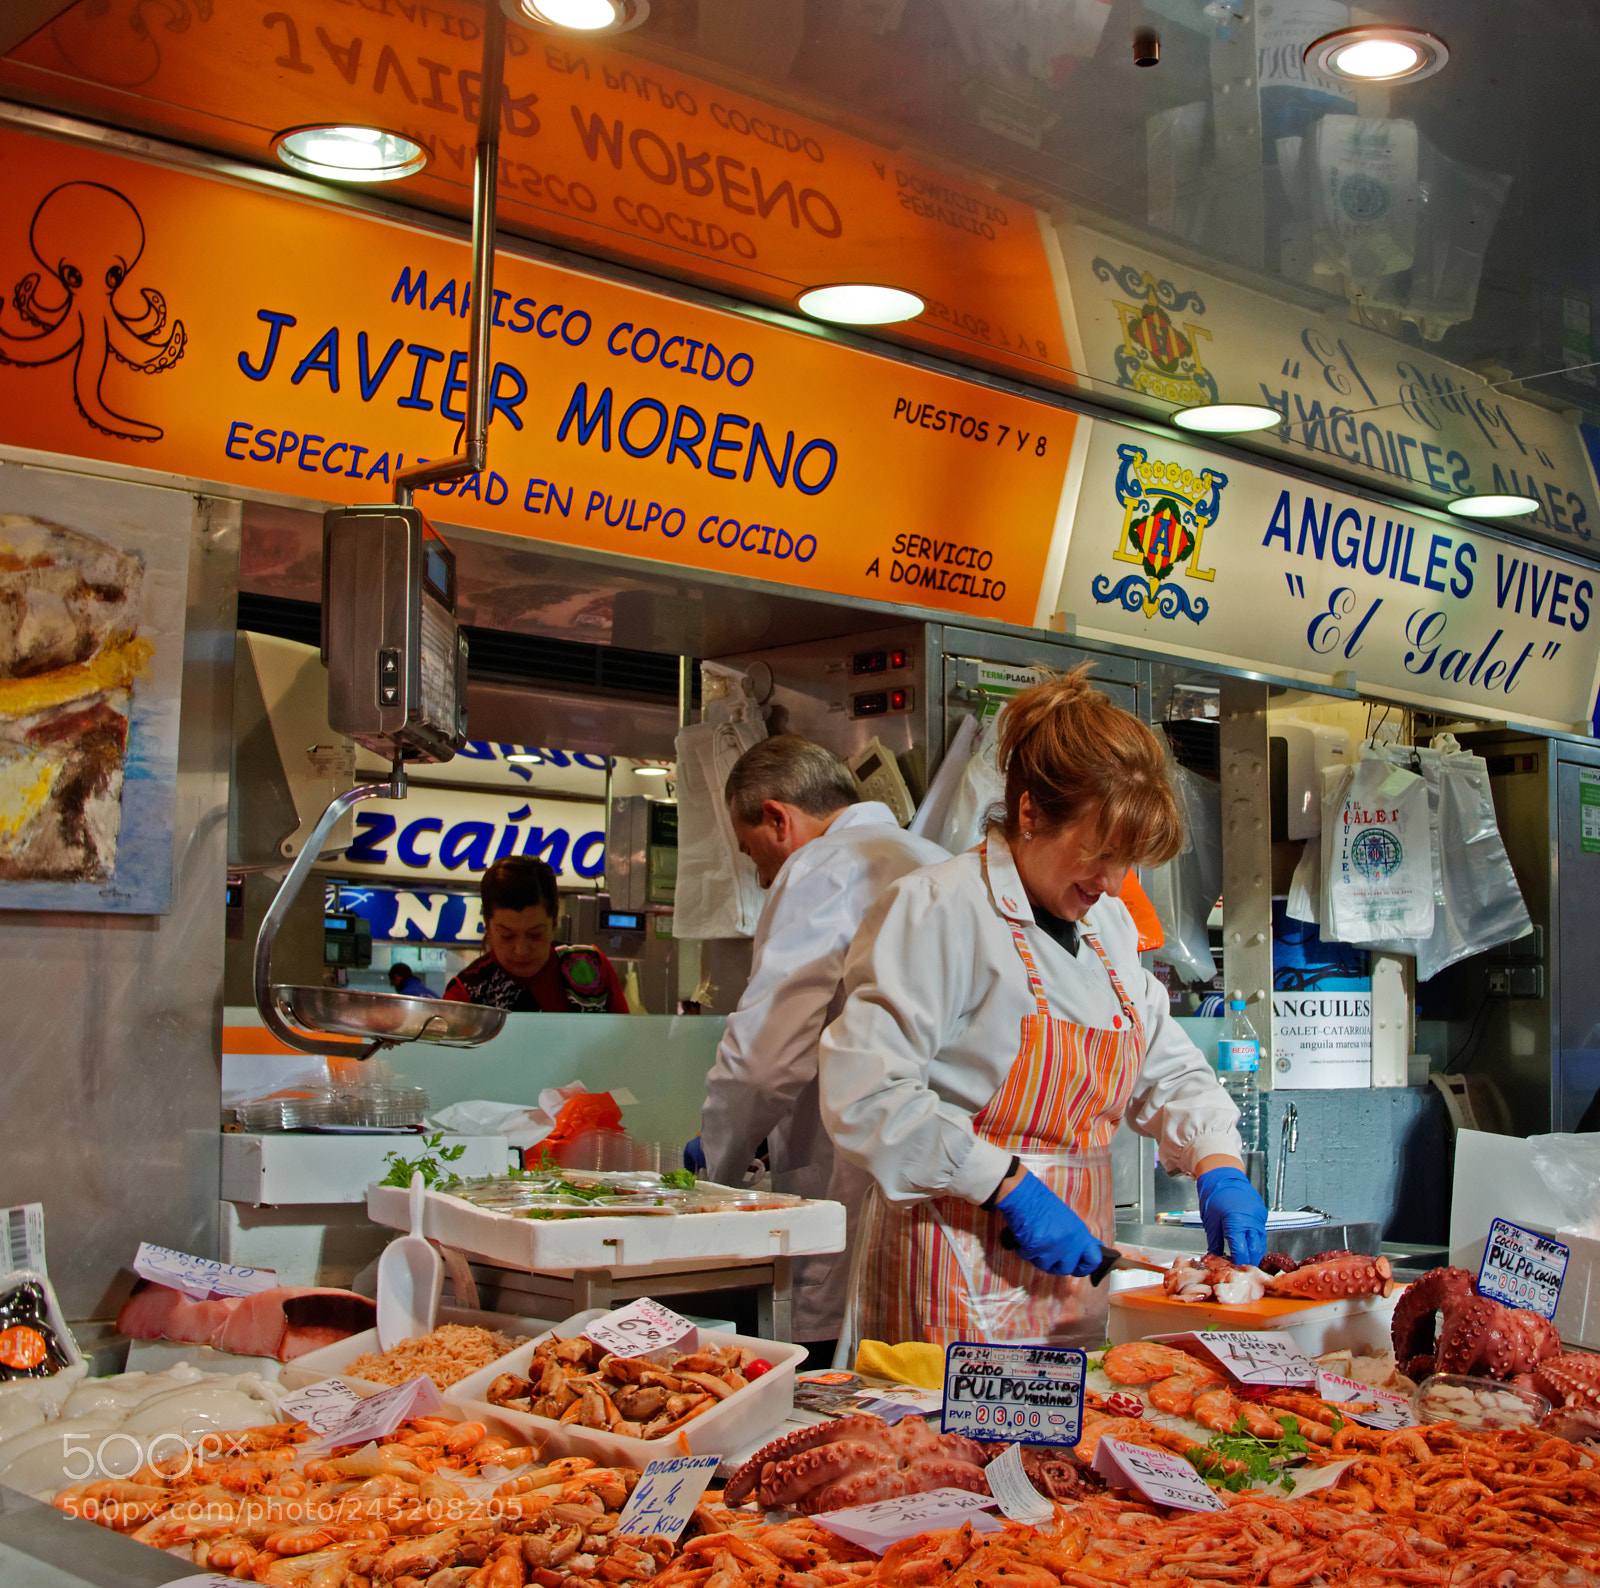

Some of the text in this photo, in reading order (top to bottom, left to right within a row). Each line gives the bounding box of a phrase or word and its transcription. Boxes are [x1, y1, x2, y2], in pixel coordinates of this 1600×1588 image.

[607, 322, 754, 387] COCIDO
[238, 308, 838, 496] JAVIER MORENO
[894, 397, 1048, 457] PUESTOS 7 Y 8
[523, 478, 574, 517] EN
[585, 490, 686, 538] PULPO
[698, 515, 818, 563] COCIDO
[891, 533, 994, 572] SERVICIO
[1261, 489, 1595, 633] ANGUILES VIVES
[866, 557, 1007, 602] A DOMICILIO
[1343, 808, 1400, 826] GALET
[1273, 999, 1371, 1018] ANGUILES
[1300, 1040, 1334, 1051] anguila
[1335, 1041, 1360, 1049] maresa
[1494, 1235, 1524, 1253] COCIDO
[959, 1362, 1004, 1377] COCIDO
[953, 1375, 1027, 1401] PULPO
[1065, 1420, 1077, 1433] €
